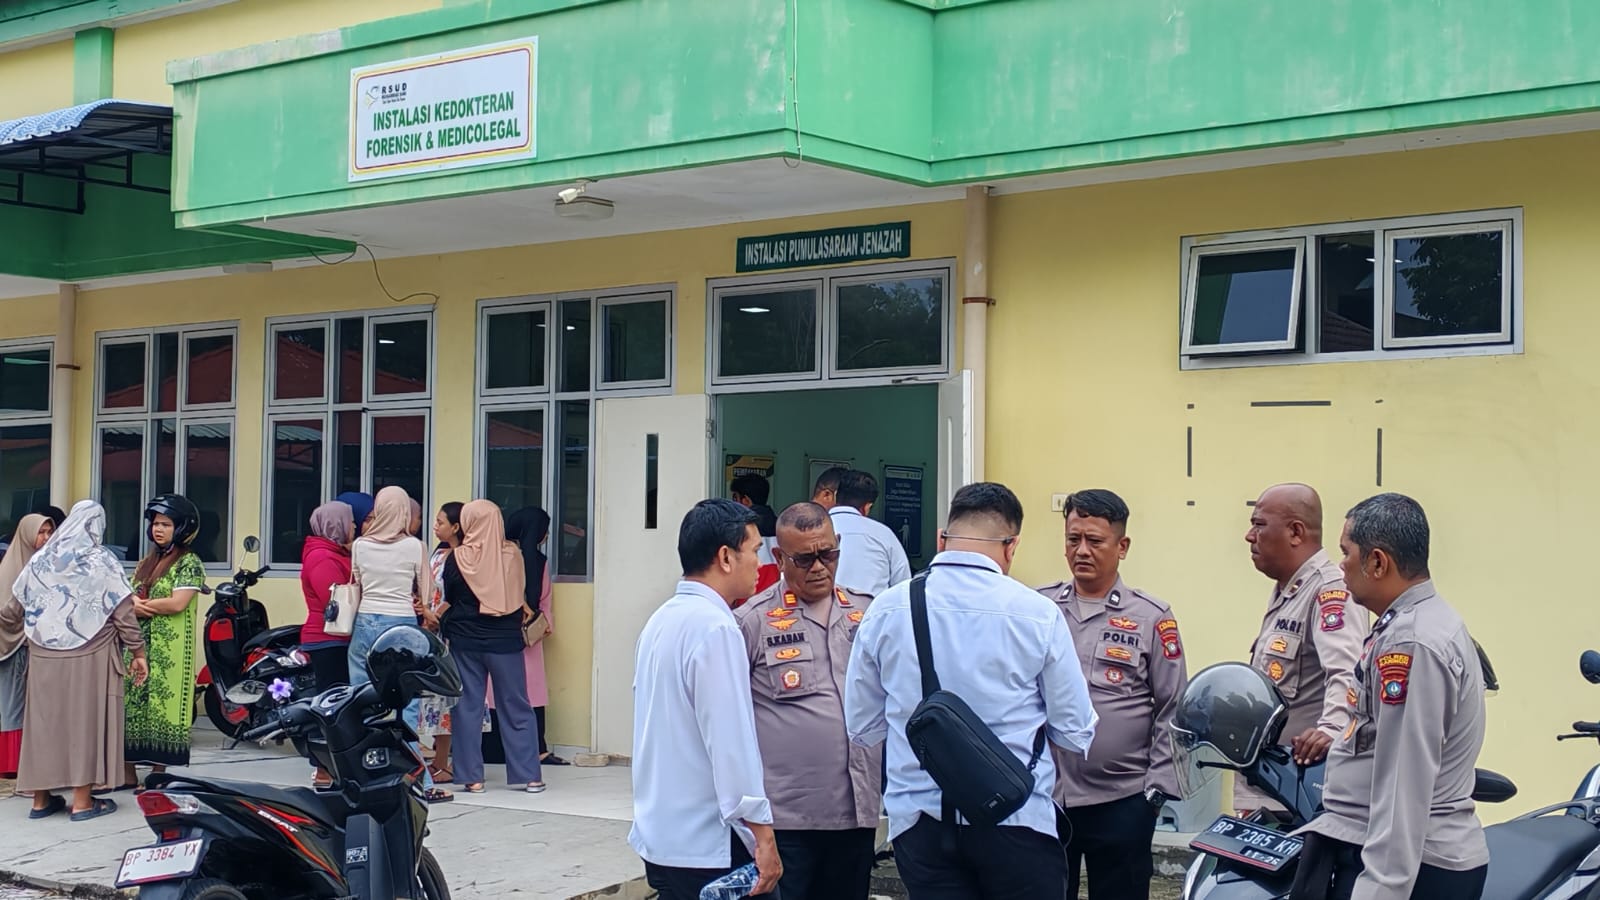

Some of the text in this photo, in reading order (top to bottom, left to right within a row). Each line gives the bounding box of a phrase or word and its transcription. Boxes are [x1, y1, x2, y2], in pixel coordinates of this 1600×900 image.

[373, 91, 515, 131] INSTALASI KEDOKTERAN
[366, 118, 521, 158] FORENSIK & MEDICOLEGAL
[745, 229, 902, 266] INSTALASI PUMULASARAAN JENAZAH
[1103, 631, 1139, 648] POLRI
[1275, 618, 1302, 634] POLRI
[125, 842, 199, 866] BP 3384 YX
[1212, 821, 1234, 834] BP
[1273, 839, 1300, 855] KH
